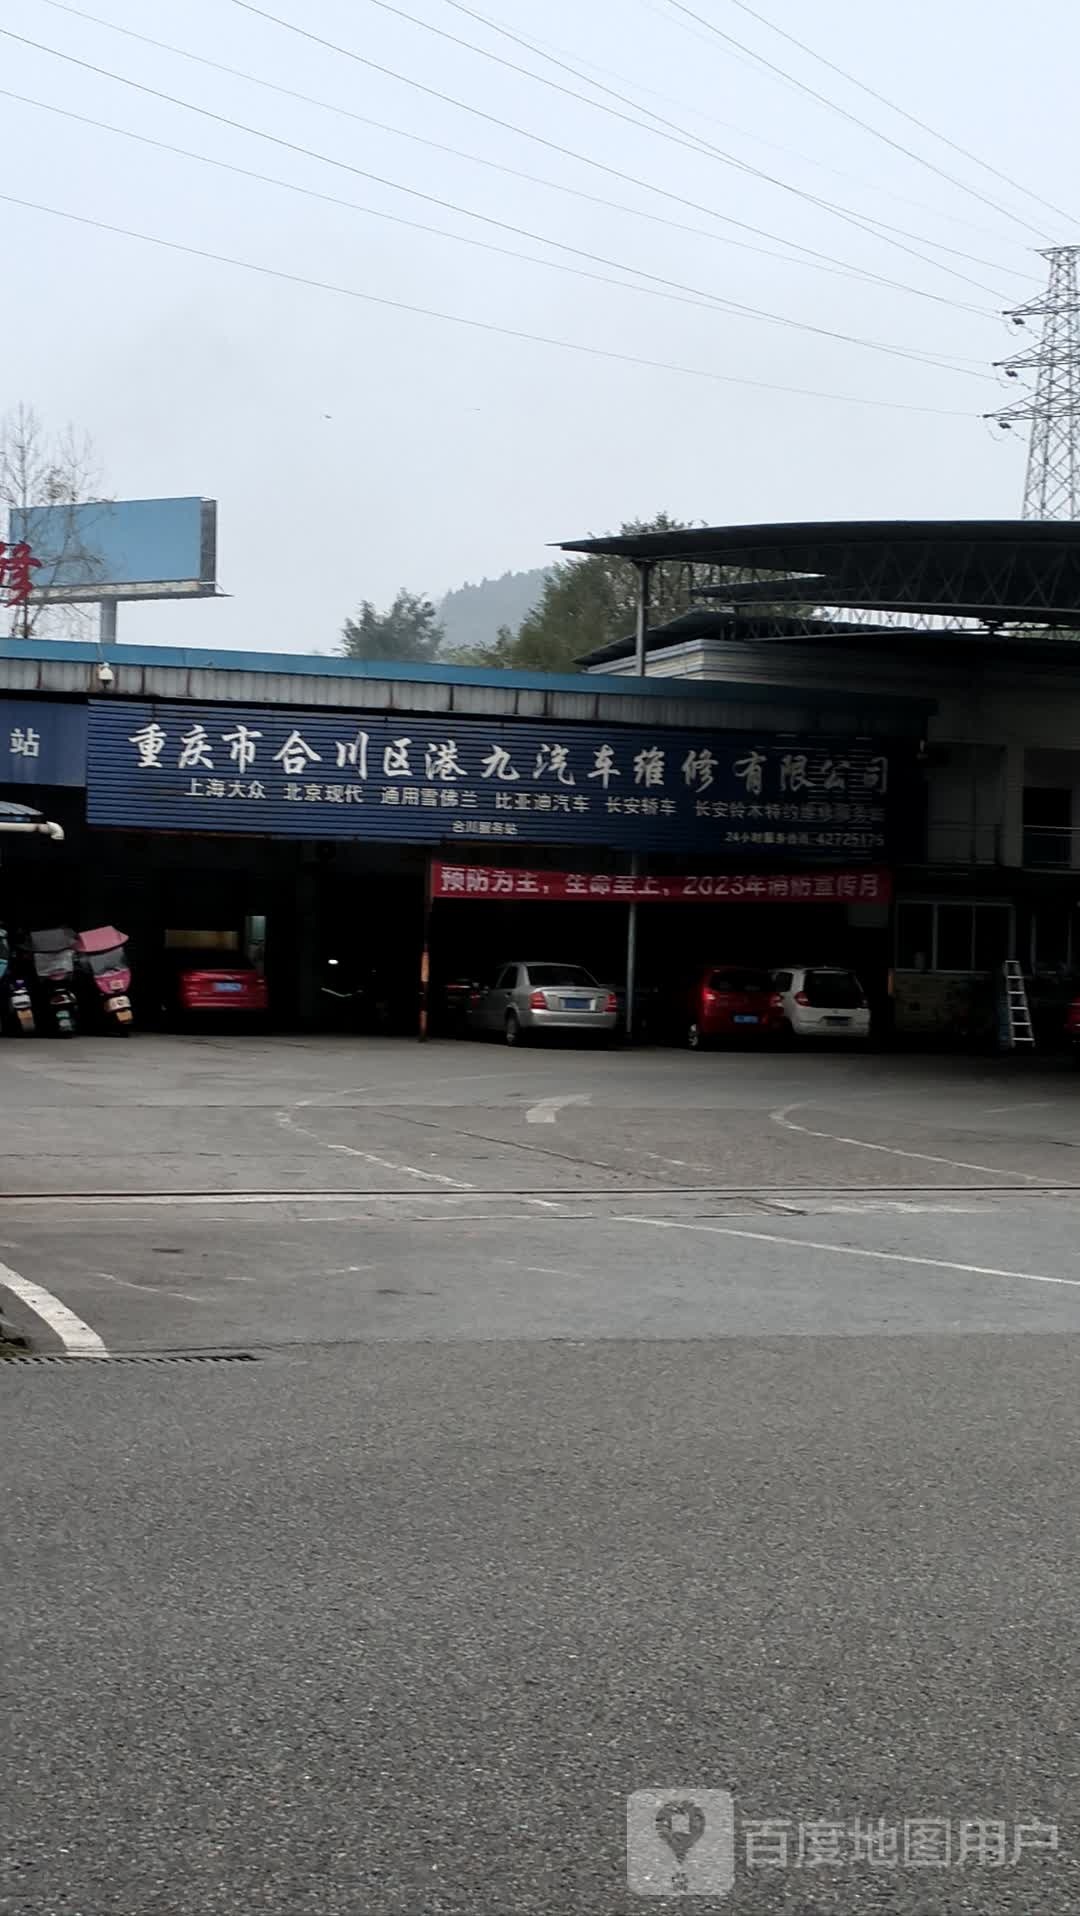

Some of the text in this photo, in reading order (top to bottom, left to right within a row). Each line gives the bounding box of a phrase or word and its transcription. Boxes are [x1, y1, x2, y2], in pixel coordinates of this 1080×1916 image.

[9, 727, 41, 758] 站
[128, 723, 889, 795] 重庆市合川区港九汽车维修有限公司
[185, 778, 266, 801] 上海大众
[283, 783, 364, 805] 北京现代
[380, 786, 479, 809] 通用雪佛兰
[495, 792, 591, 814] 比亚迪汽车
[605, 796, 678, 817] 长安轿车
